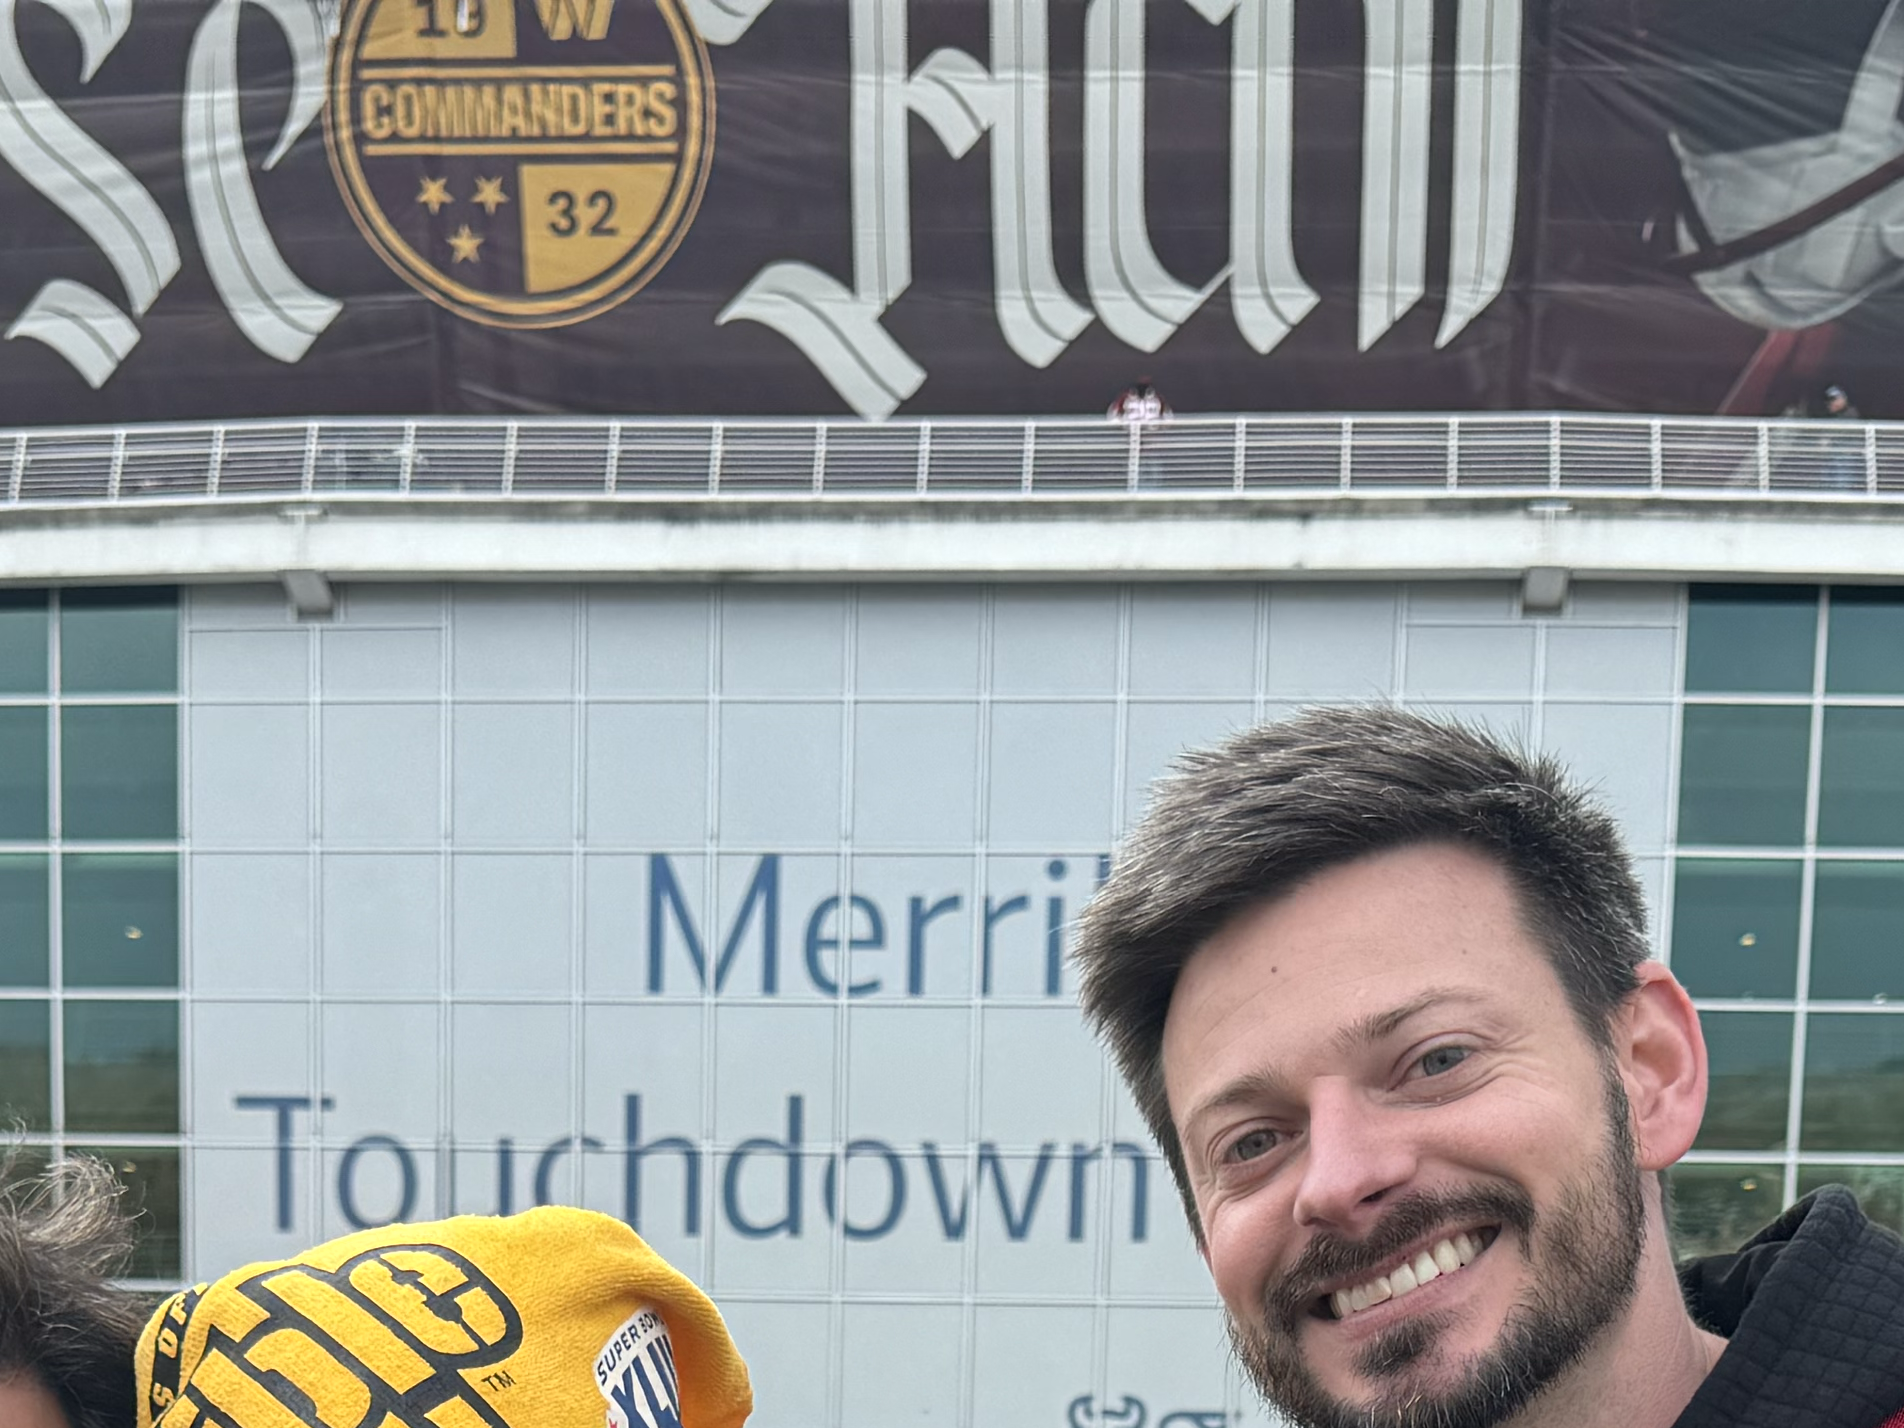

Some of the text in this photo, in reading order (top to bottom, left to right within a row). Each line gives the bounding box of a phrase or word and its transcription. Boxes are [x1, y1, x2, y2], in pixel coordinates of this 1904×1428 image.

[361, 82, 678, 139] COMMANDERS
[547, 189, 619, 237] 32
[647, 853, 1111, 998] Merri
[233, 1092, 1149, 1244] Touchdown
[596, 1324, 642, 1388] SUPER
